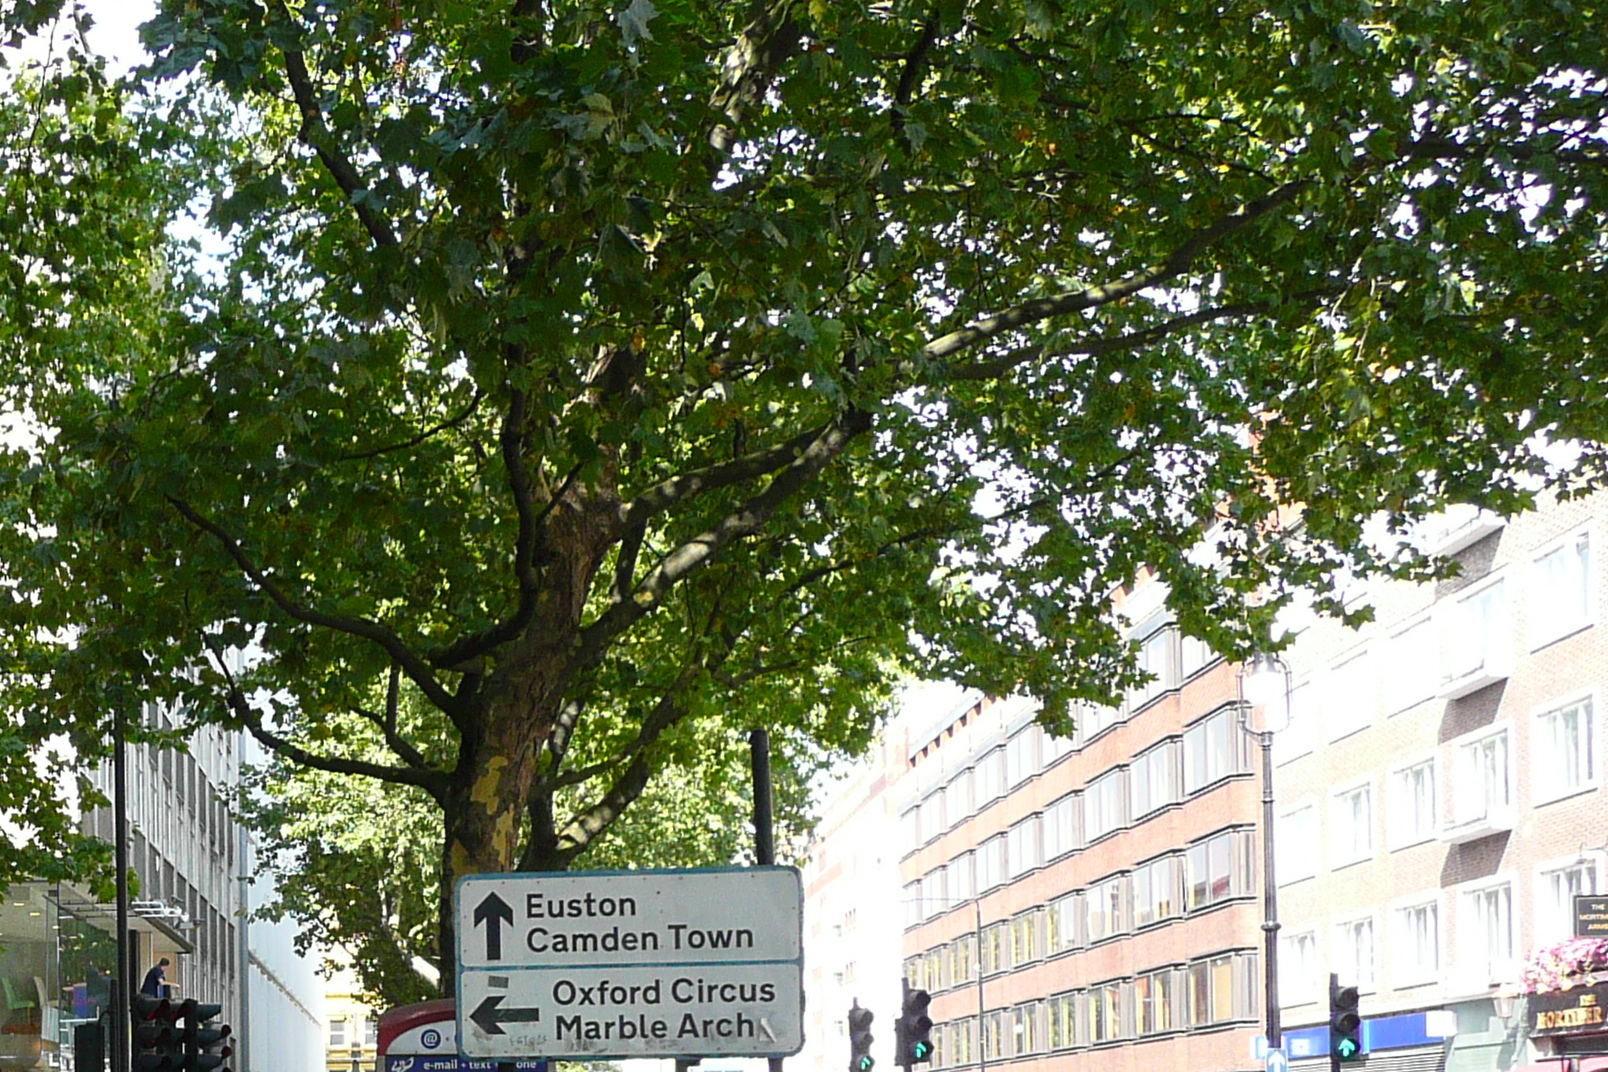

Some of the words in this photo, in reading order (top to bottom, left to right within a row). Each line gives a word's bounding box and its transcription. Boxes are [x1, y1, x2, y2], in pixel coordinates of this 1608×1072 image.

[525, 892, 636, 919] Euston
[526, 927, 659, 953] Camden
[667, 924, 754, 950] Town
[552, 979, 661, 1006] Oxford
[670, 977, 776, 1003] Circus
[555, 1014, 667, 1041] Marble
[676, 1012, 755, 1039] Arch
[423, 1059, 458, 1070] e-mail
[469, 1060, 492, 1070] text
